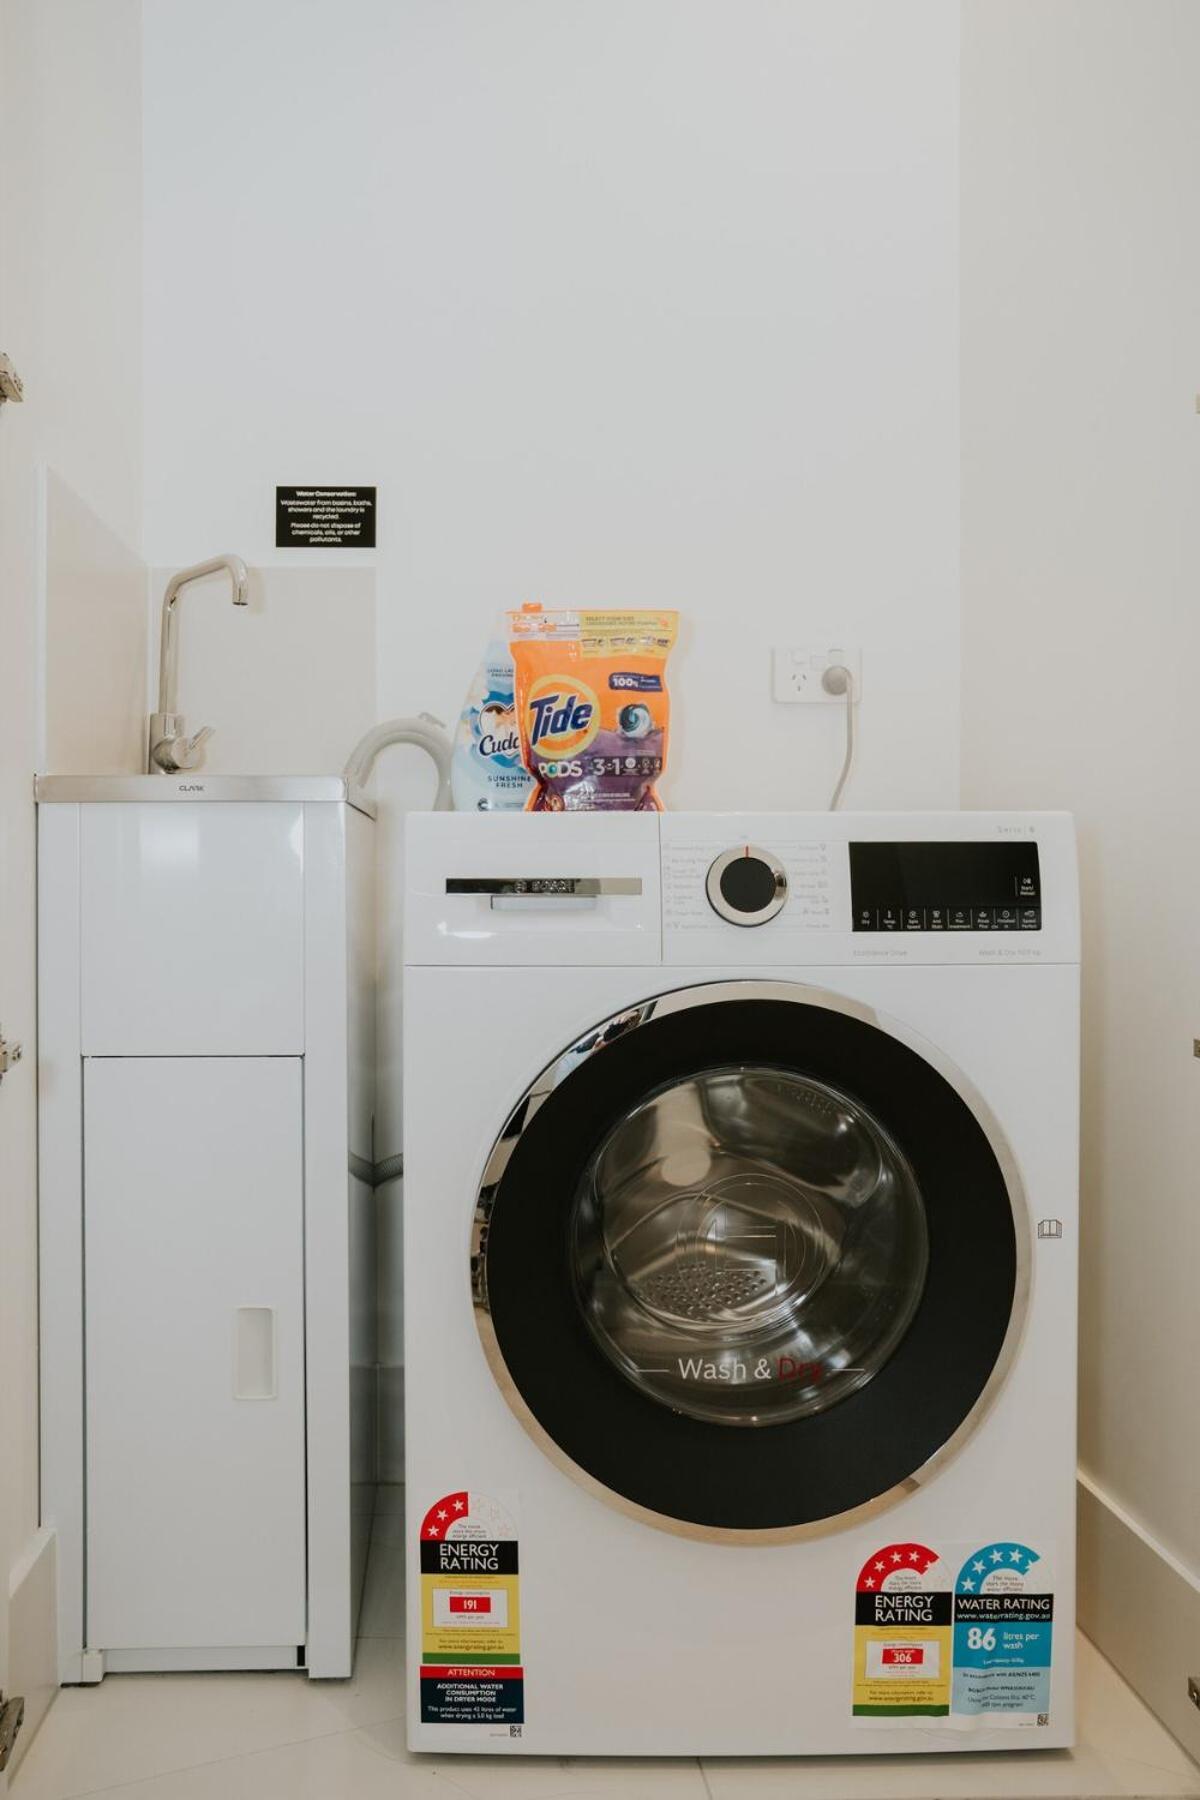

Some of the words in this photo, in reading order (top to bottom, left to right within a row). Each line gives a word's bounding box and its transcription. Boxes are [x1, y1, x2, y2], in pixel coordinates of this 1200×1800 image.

[336, 506, 359, 514] laundry
[612, 678, 638, 688] 100%
[530, 694, 593, 746] Tide
[538, 760, 582, 778] PODS
[678, 1358, 747, 1380] Wash
[754, 1358, 772, 1380] &
[778, 1357, 824, 1385] Dry
[440, 1544, 499, 1557] ENERGY
[440, 1557, 499, 1570] RATING
[464, 1600, 477, 1610] 191
[875, 1595, 934, 1608] ENERGY
[958, 1599, 1000, 1610] WATER
[1003, 1599, 1050, 1610] RATING
[875, 1609, 933, 1622] RATING
[967, 1627, 996, 1651] 86
[1003, 1632, 1024, 1640] litres
[1025, 1633, 1040, 1641] per
[894, 1653, 912, 1663] 306
[448, 1668, 495, 1677] ATTENTION
